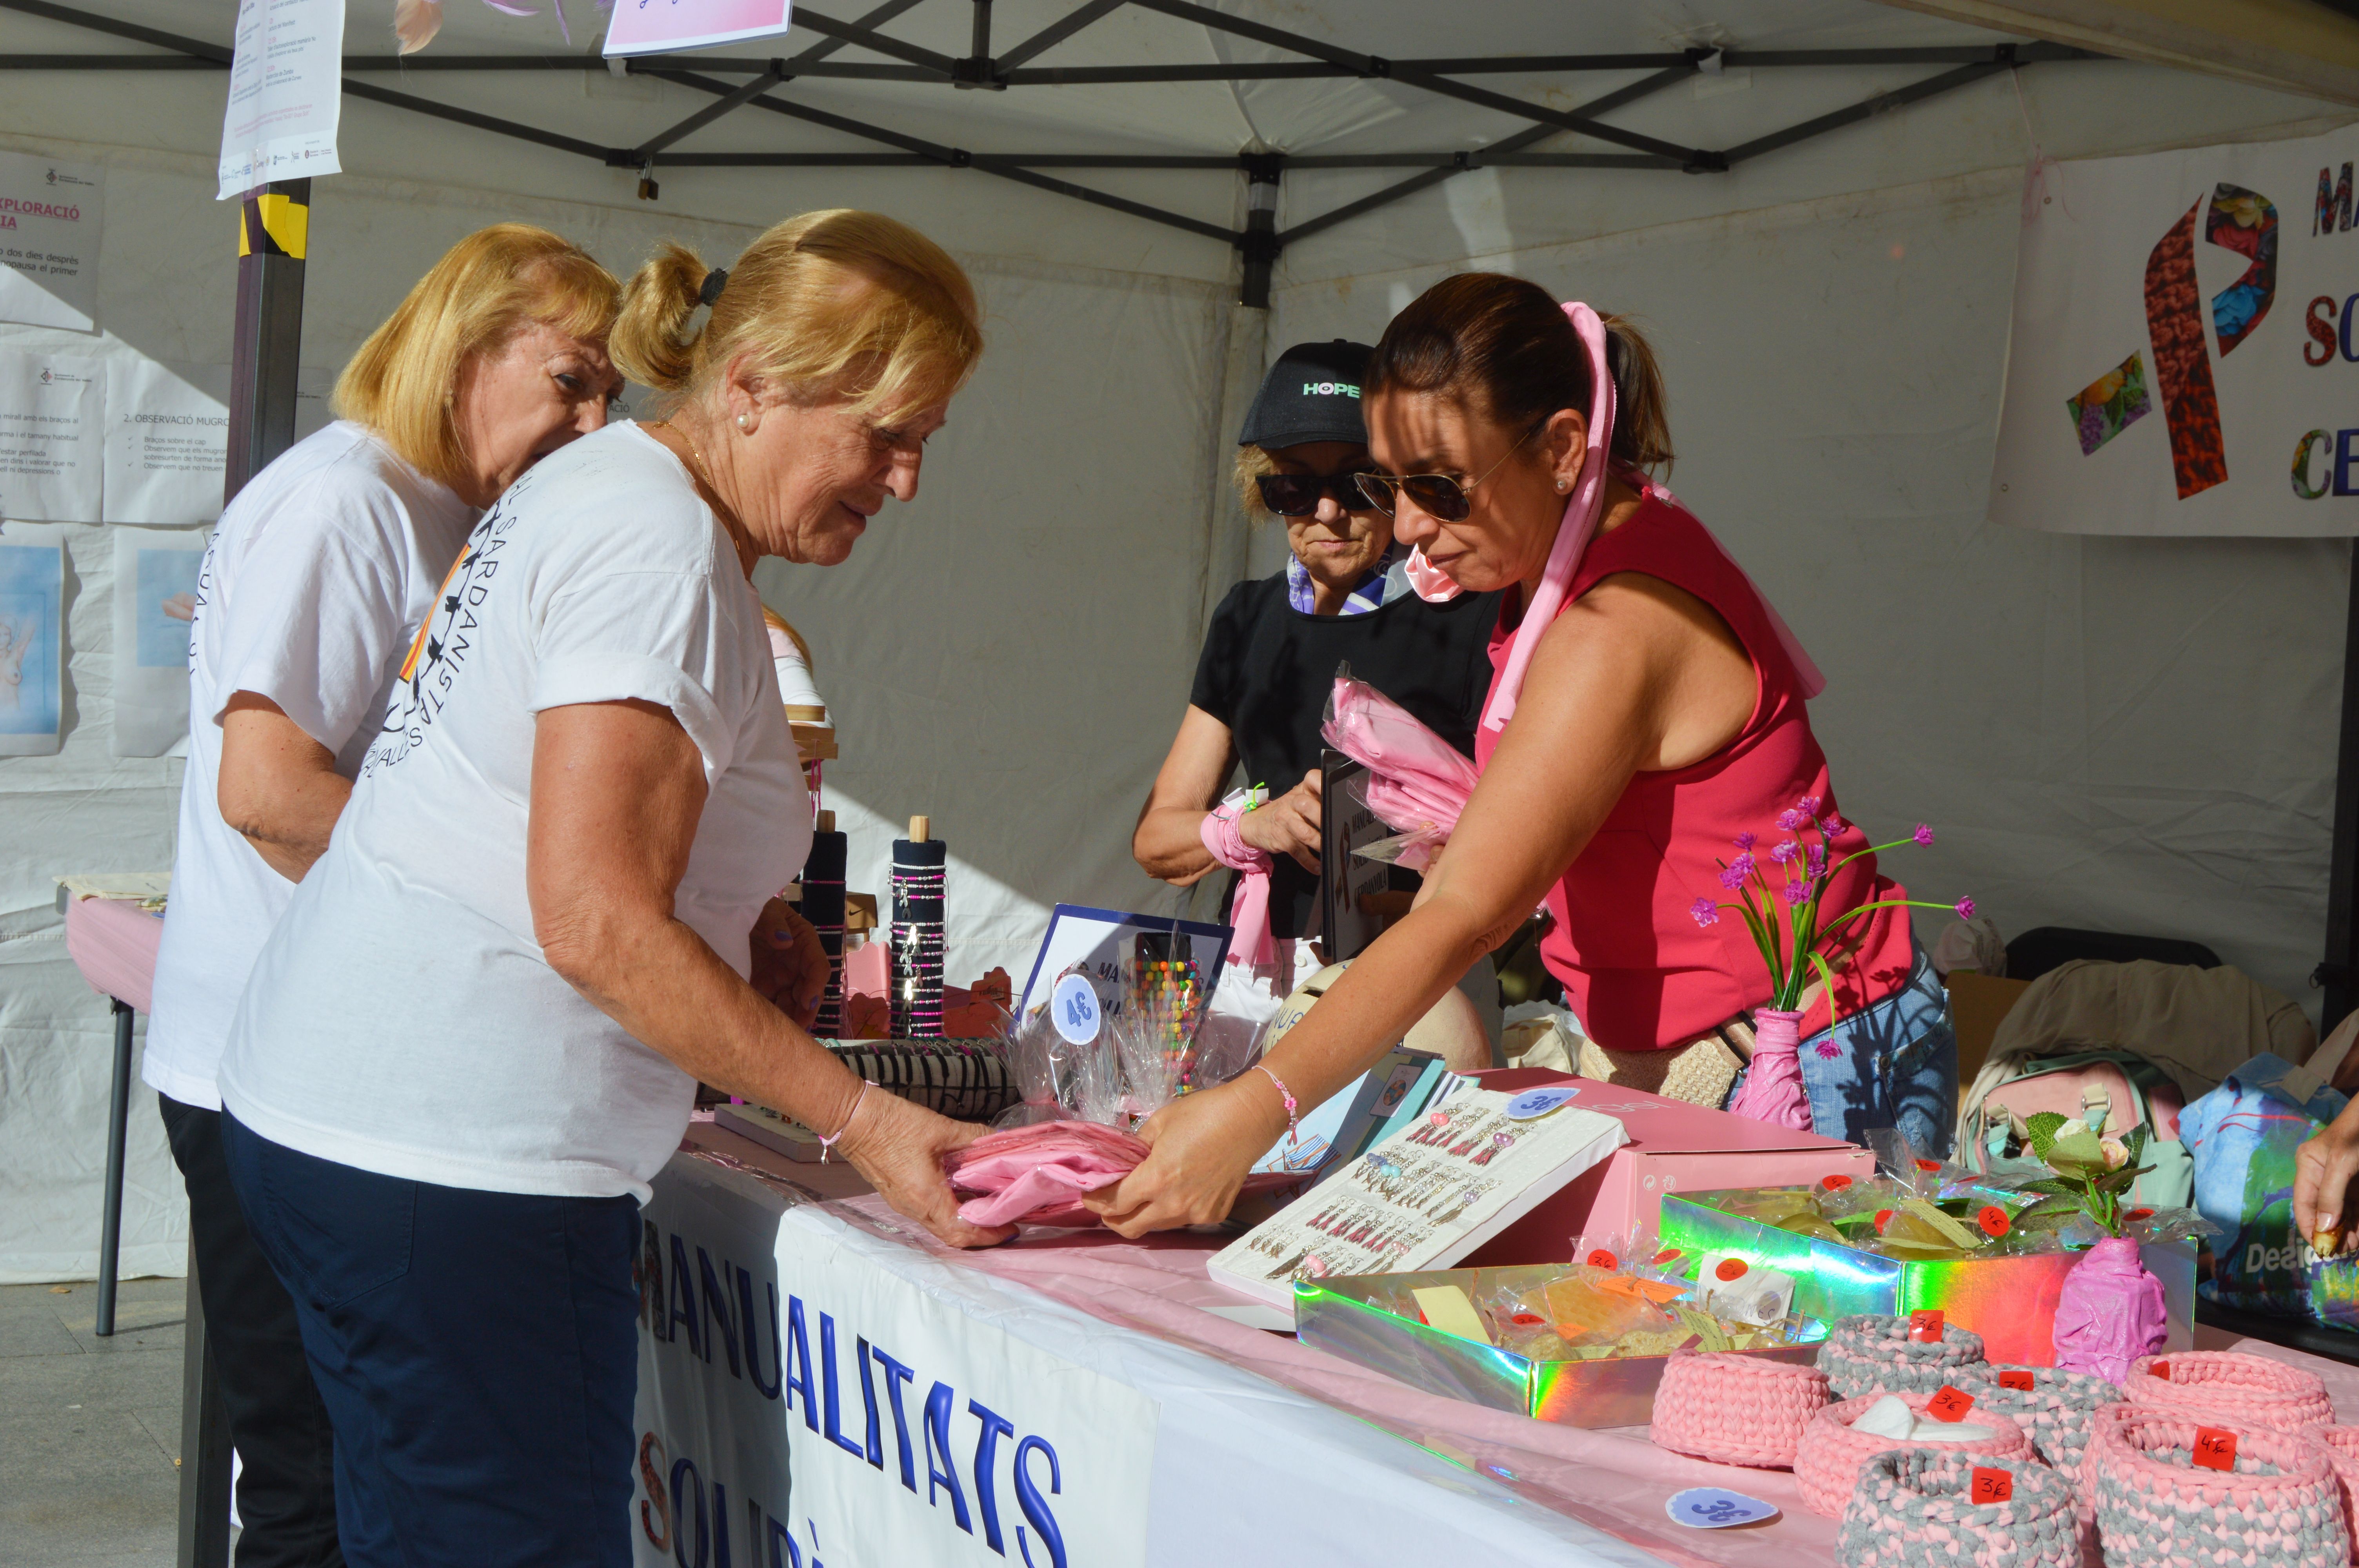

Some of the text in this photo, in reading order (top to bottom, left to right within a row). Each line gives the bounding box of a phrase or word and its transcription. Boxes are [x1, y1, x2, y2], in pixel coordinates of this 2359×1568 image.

[7, 248, 22, 257] dos
[26, 250, 43, 260] dies
[47, 253, 79, 265] desprès
[50, 266, 78, 276] primer
[1303, 382, 1360, 399] HOPE
[49, 416, 71, 424] braços
[124, 414, 132, 422] 2.
[135, 414, 193, 425] OBSERVACIÓ
[17, 466, 54, 475] depressions
[1066, 991, 1092, 1027] 4€
[1520, 1096, 1562, 1111] 3€
[1988, 1210, 2001, 1228] 4€
[1917, 1318, 1936, 1332] 3€
[1936, 1390, 1962, 1412] 3€
[2200, 1435, 2229, 1454] 4€
[1981, 1477, 2007, 1497] 3€
[1691, 1500, 1752, 1522] 3€
